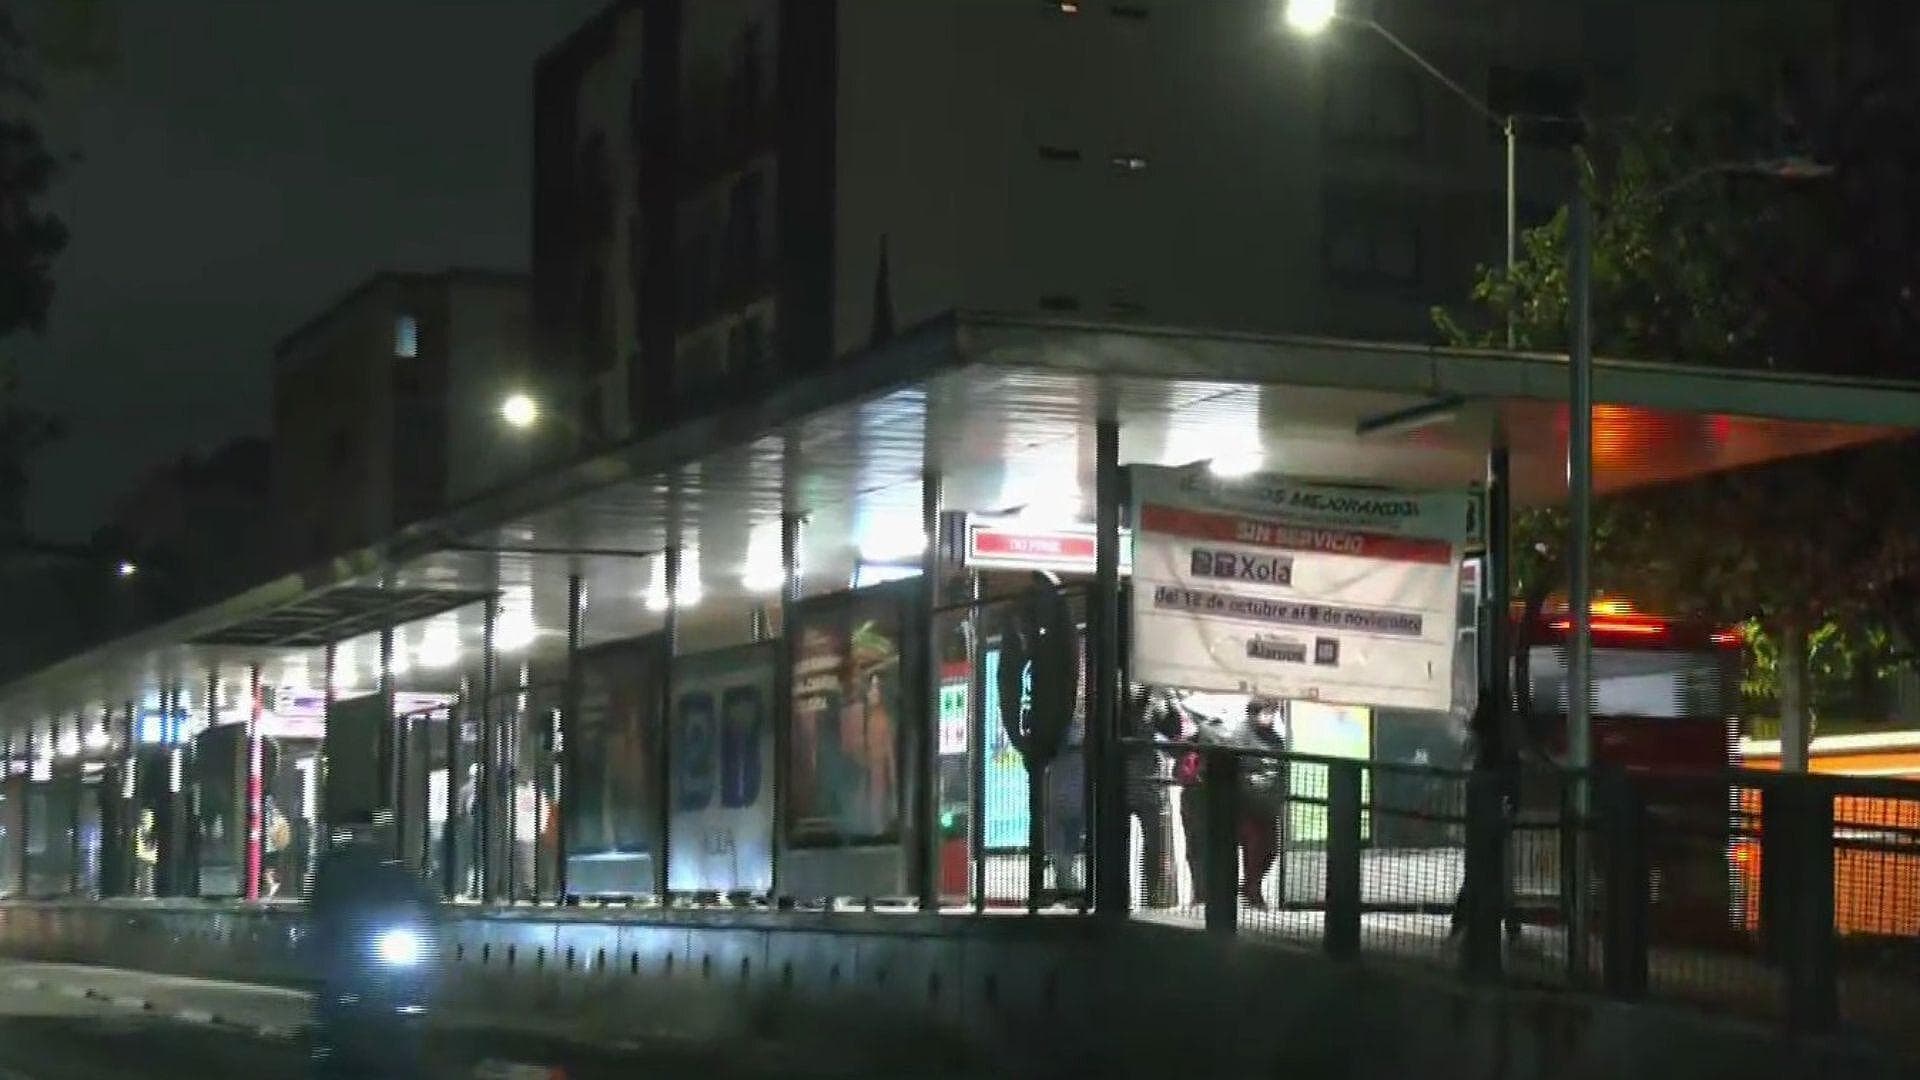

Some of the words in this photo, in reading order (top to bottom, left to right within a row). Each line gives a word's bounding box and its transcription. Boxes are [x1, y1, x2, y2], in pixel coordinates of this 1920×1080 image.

[1237, 519, 1271, 543] SIN
[1276, 524, 1365, 551] SERVICIO
[1241, 555, 1291, 584] Xola
[1206, 594, 1225, 609] de
[1229, 598, 1287, 618] octubre
[1323, 607, 1341, 623] de
[1345, 611, 1422, 632] noviembre
